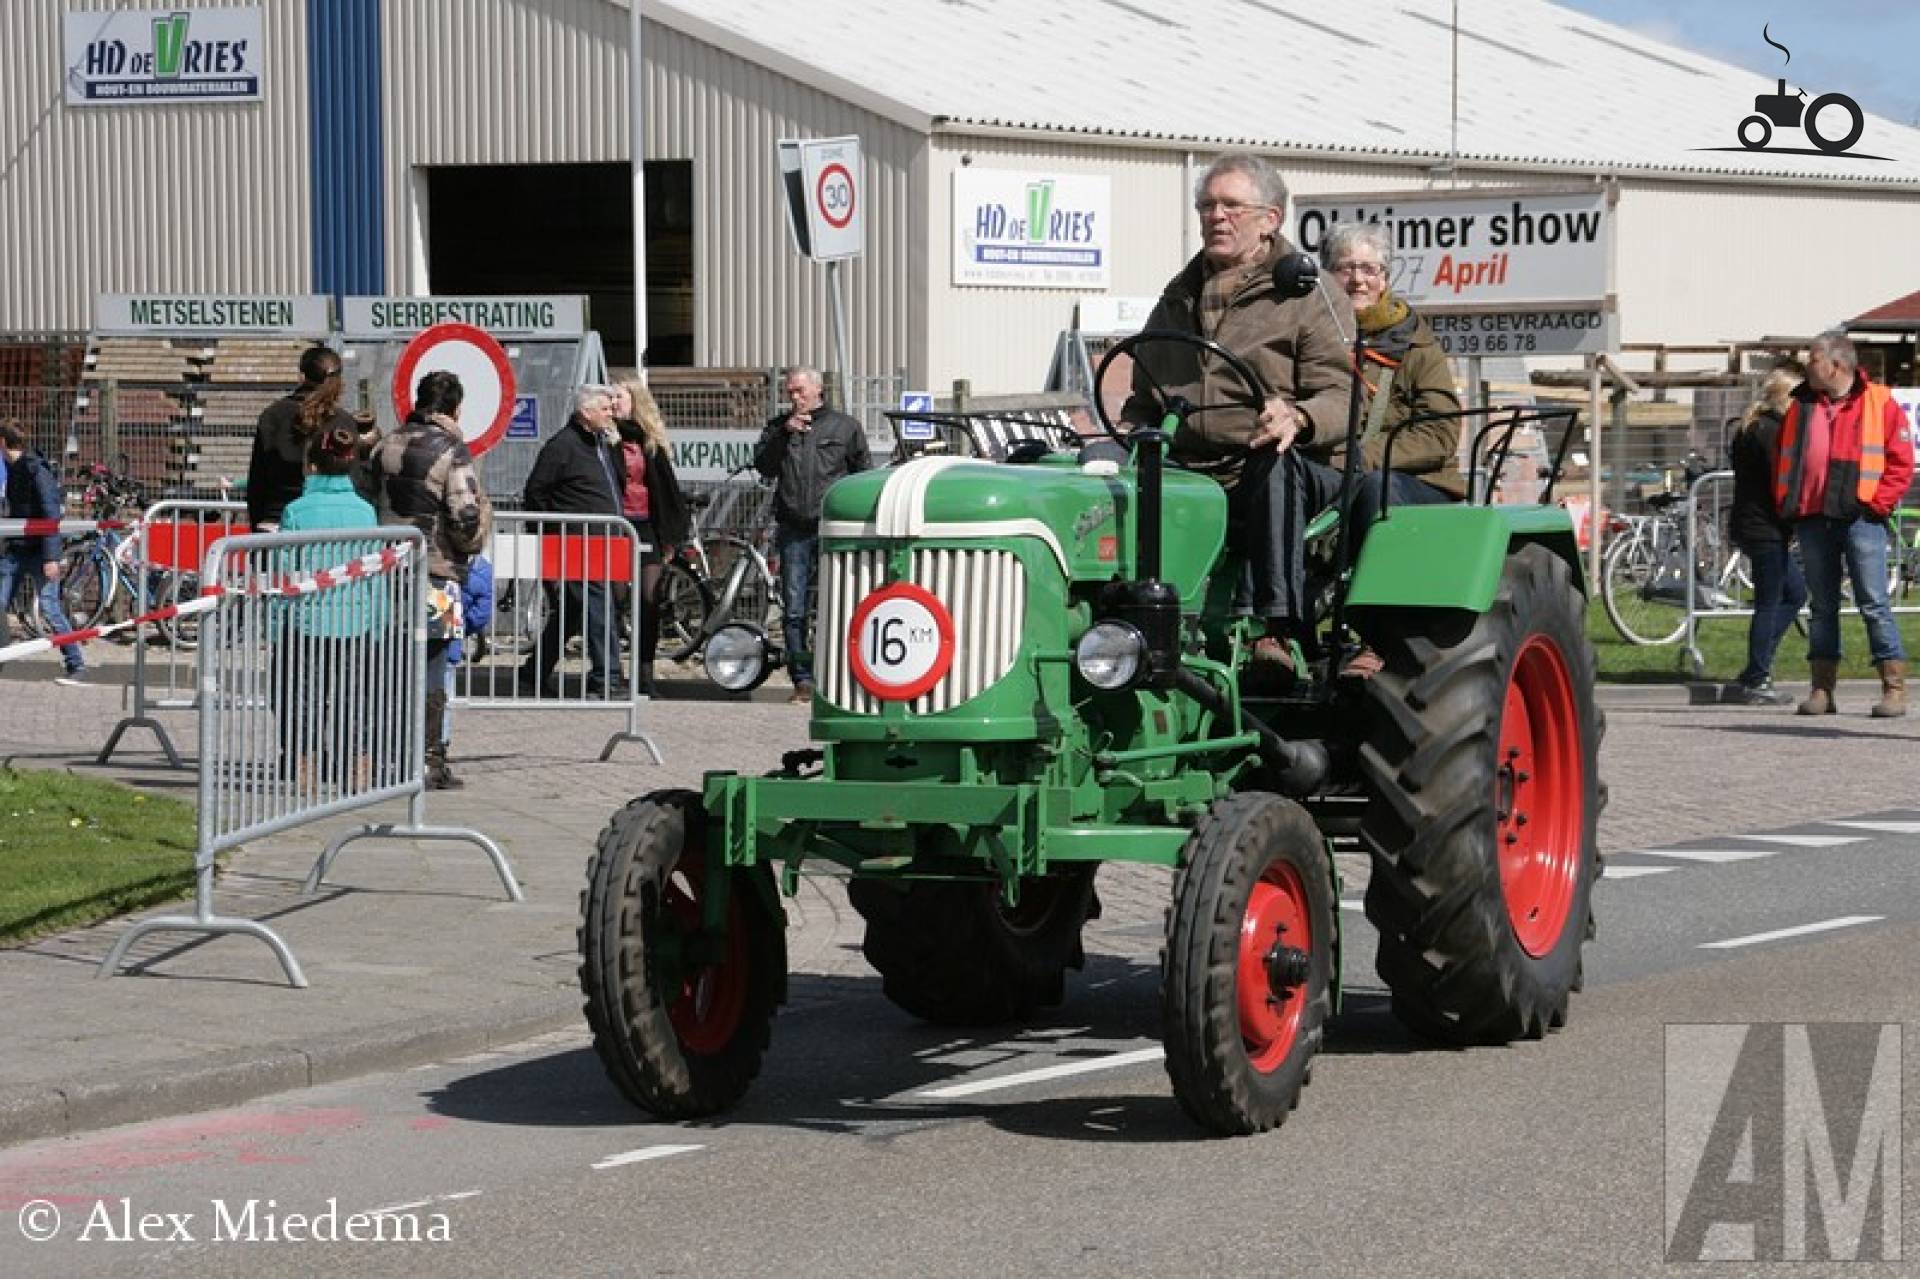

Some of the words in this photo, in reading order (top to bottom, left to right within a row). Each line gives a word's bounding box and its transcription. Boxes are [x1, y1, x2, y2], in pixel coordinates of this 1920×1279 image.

[86, 40, 127, 75] HD
[152, 12, 248, 80] VRIES
[825, 184, 848, 209] 30
[976, 203, 1006, 239] HD
[1026, 179, 1096, 245] VRIES
[1490, 201, 1601, 246] show
[1433, 252, 1508, 293] April
[131, 299, 294, 326] METSELSTENEN
[371, 301, 555, 328] SIERBESTRATING
[1480, 311, 1602, 331] GEVRAAGD
[1485, 335, 1508, 352] 66
[1514, 334, 1536, 351] 78
[871, 616, 907, 666] 16
[909, 627, 932, 643] KM
